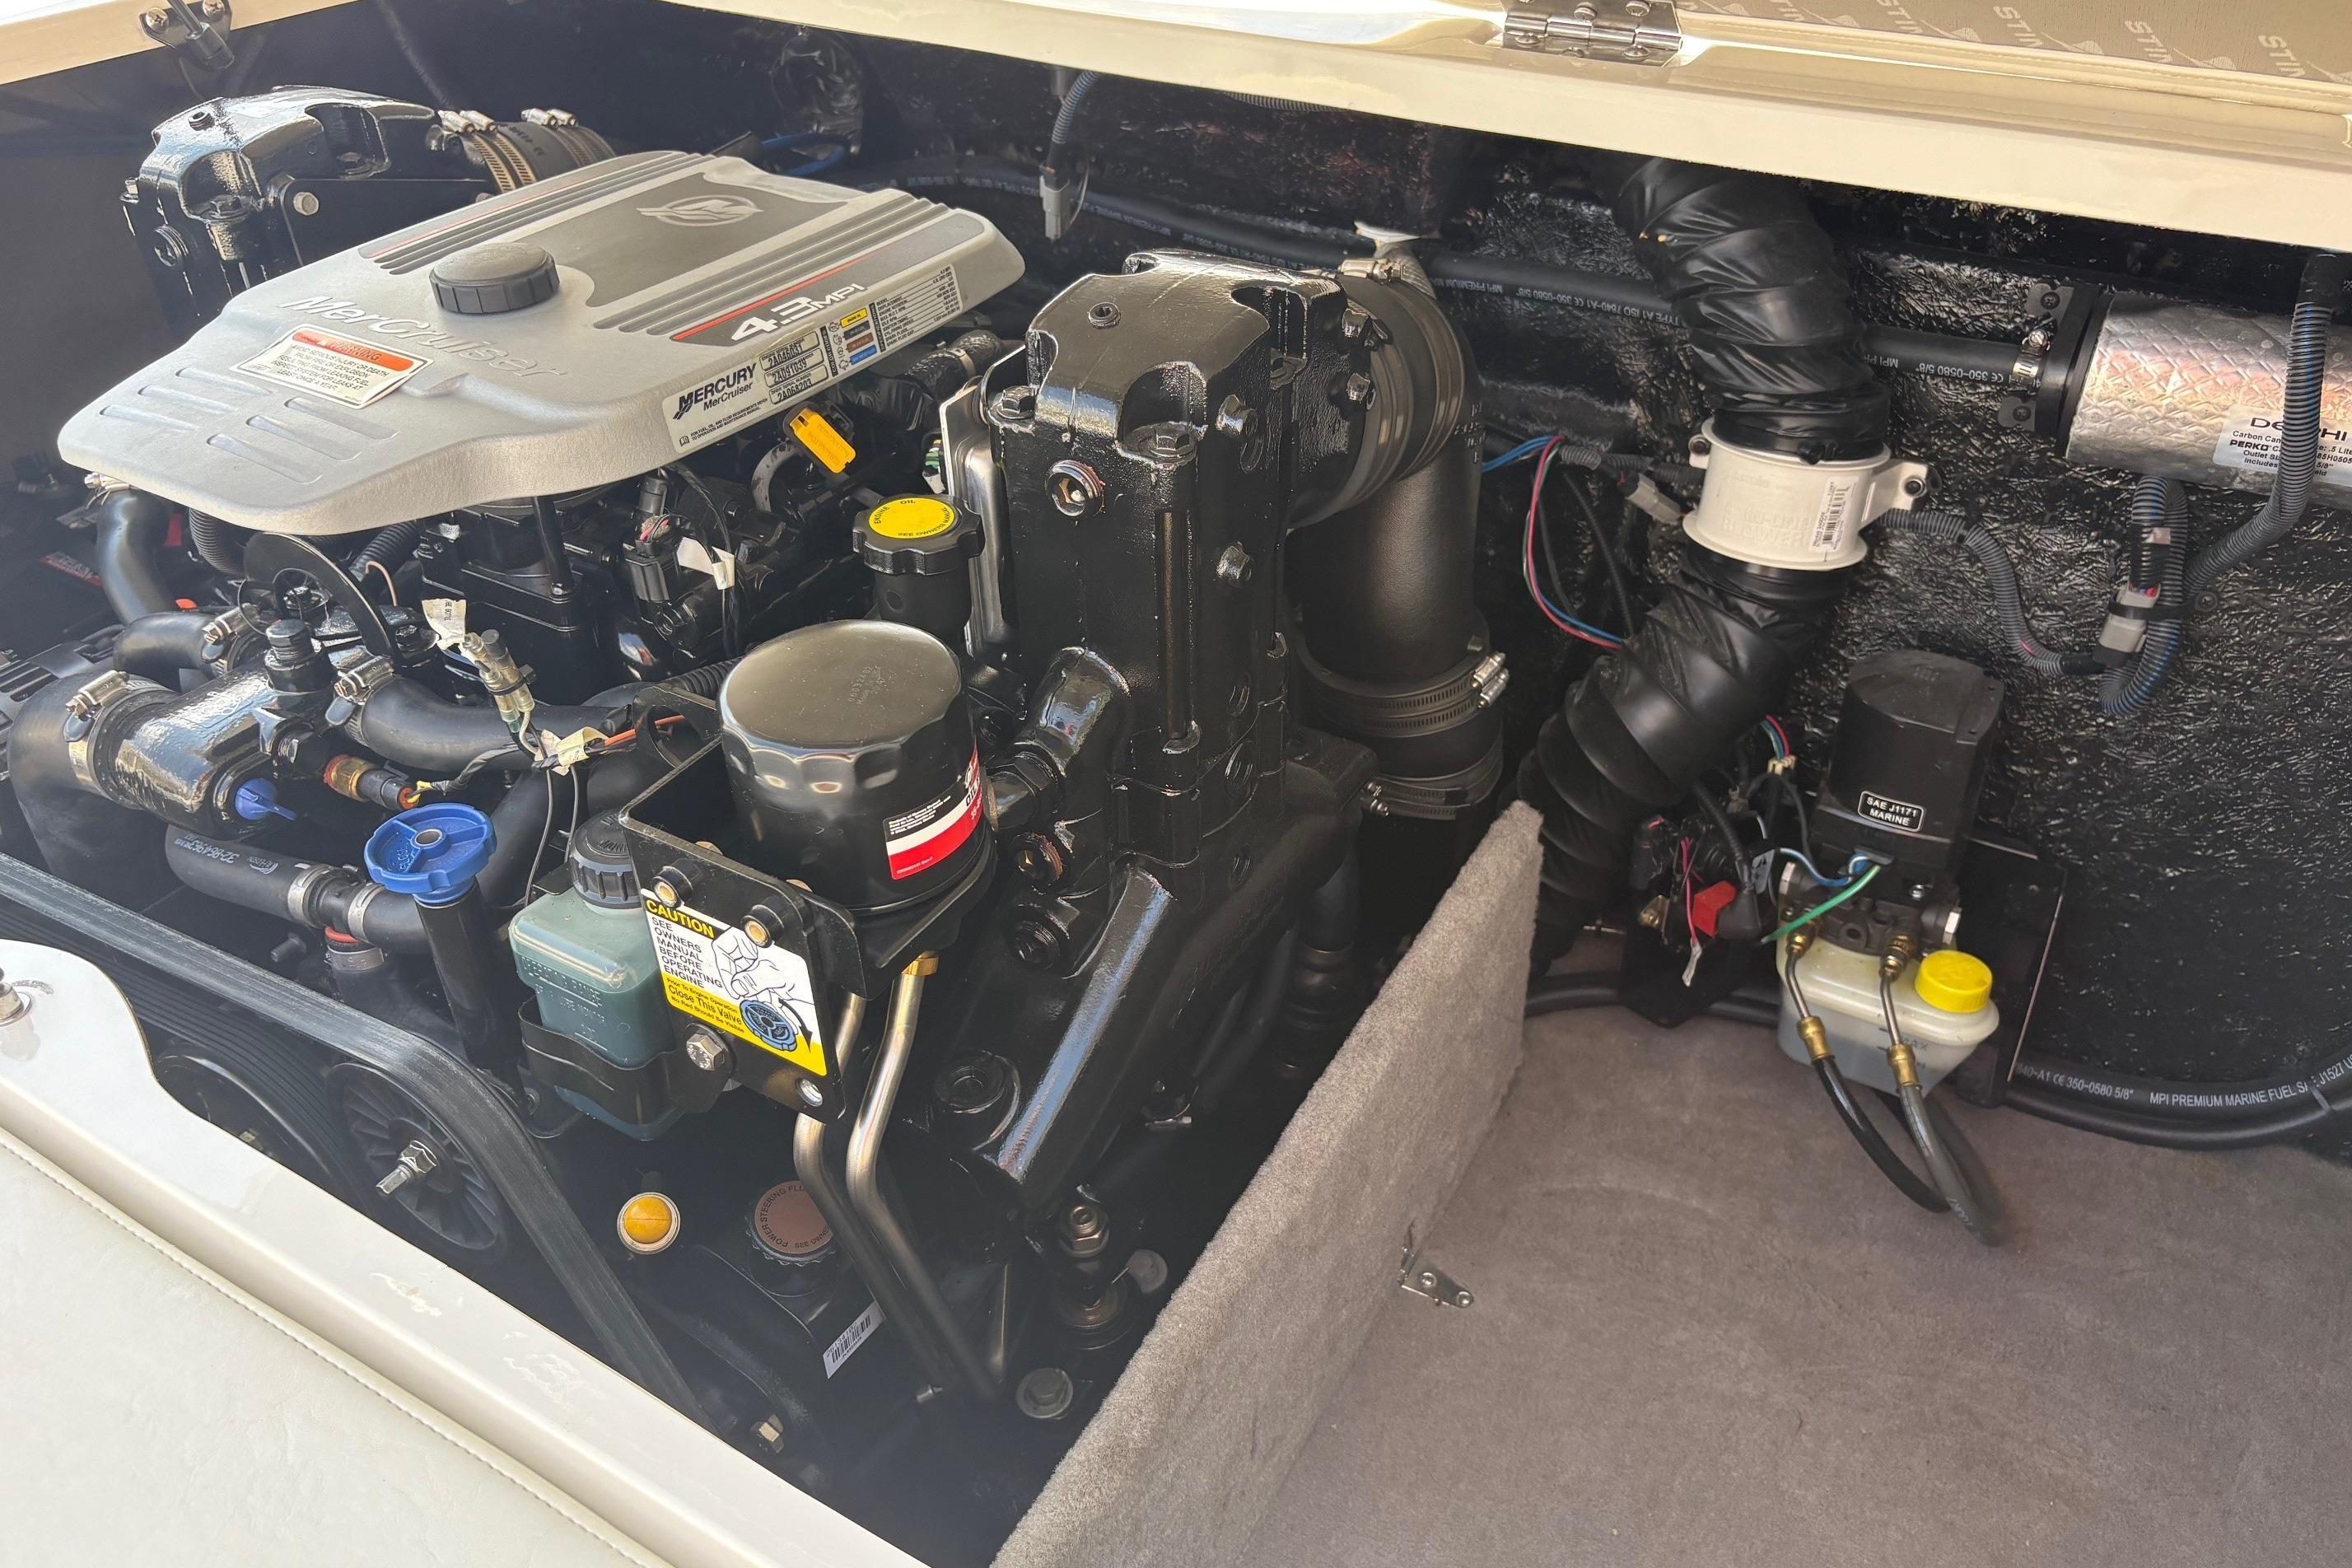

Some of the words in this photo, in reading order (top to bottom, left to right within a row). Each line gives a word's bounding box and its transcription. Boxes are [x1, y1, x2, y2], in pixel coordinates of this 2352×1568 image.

[810, 282, 866, 309] MPI
[277, 295, 568, 376] MerCruiser
[333, 364, 372, 378] EXPLOSION
[364, 366, 390, 376] DEATH
[1879, 355, 1898, 369] MPI
[1915, 362, 1934, 375] 5/8"
[1937, 366, 1989, 382] 350-0580
[324, 369, 355, 380] LEAKING
[330, 378, 354, 388] LEAKS
[676, 362, 757, 416] MERCURY
[701, 379, 754, 412] MerCruiser
[2229, 439, 2270, 451] PERKO
[2233, 430, 2264, 441] Carbon
[2243, 450, 2268, 459] Outlet
[2244, 457, 2279, 469] Includes
[1866, 796, 1888, 810] SAE
[1888, 804, 1917, 818] J1171
[1869, 808, 1911, 826] MARINE
[645, 896, 716, 940] CAUTION
[651, 915, 673, 933] SEE
[653, 925, 702, 954] OWNERS
[656, 935, 703, 964] MANUAL
[658, 945, 702, 971] BEFORE
[660, 954, 723, 989] OPERATING
[663, 964, 704, 988] ENGINE
[666, 978, 683, 989] Prior
[688, 987, 709, 1001] Engine
[709, 996, 738, 1015] Operation
[668, 984, 695, 1004] Close
[696, 996, 716, 1013] This
[716, 1006, 742, 1025] Valve
[679, 999, 693, 1010] Red
[694, 1006, 715, 1020] Should
[725, 1020, 744, 1034] Visible
[2065, 1076, 2112, 1097] 350-0580
[2115, 1087, 2135, 1101] 5/8"
[2149, 1091, 2169, 1106] MPI
[2172, 1093, 2224, 1108] PREMIUM
[2225, 1090, 2268, 1107] MARINE
[2269, 1084, 2298, 1102] FUEL
[2318, 1063, 2345, 1085] J1527
[760, 1187, 787, 1223] STEERING
[761, 1223, 790, 1248] POWER
[794, 1241, 810, 1249] SEE
